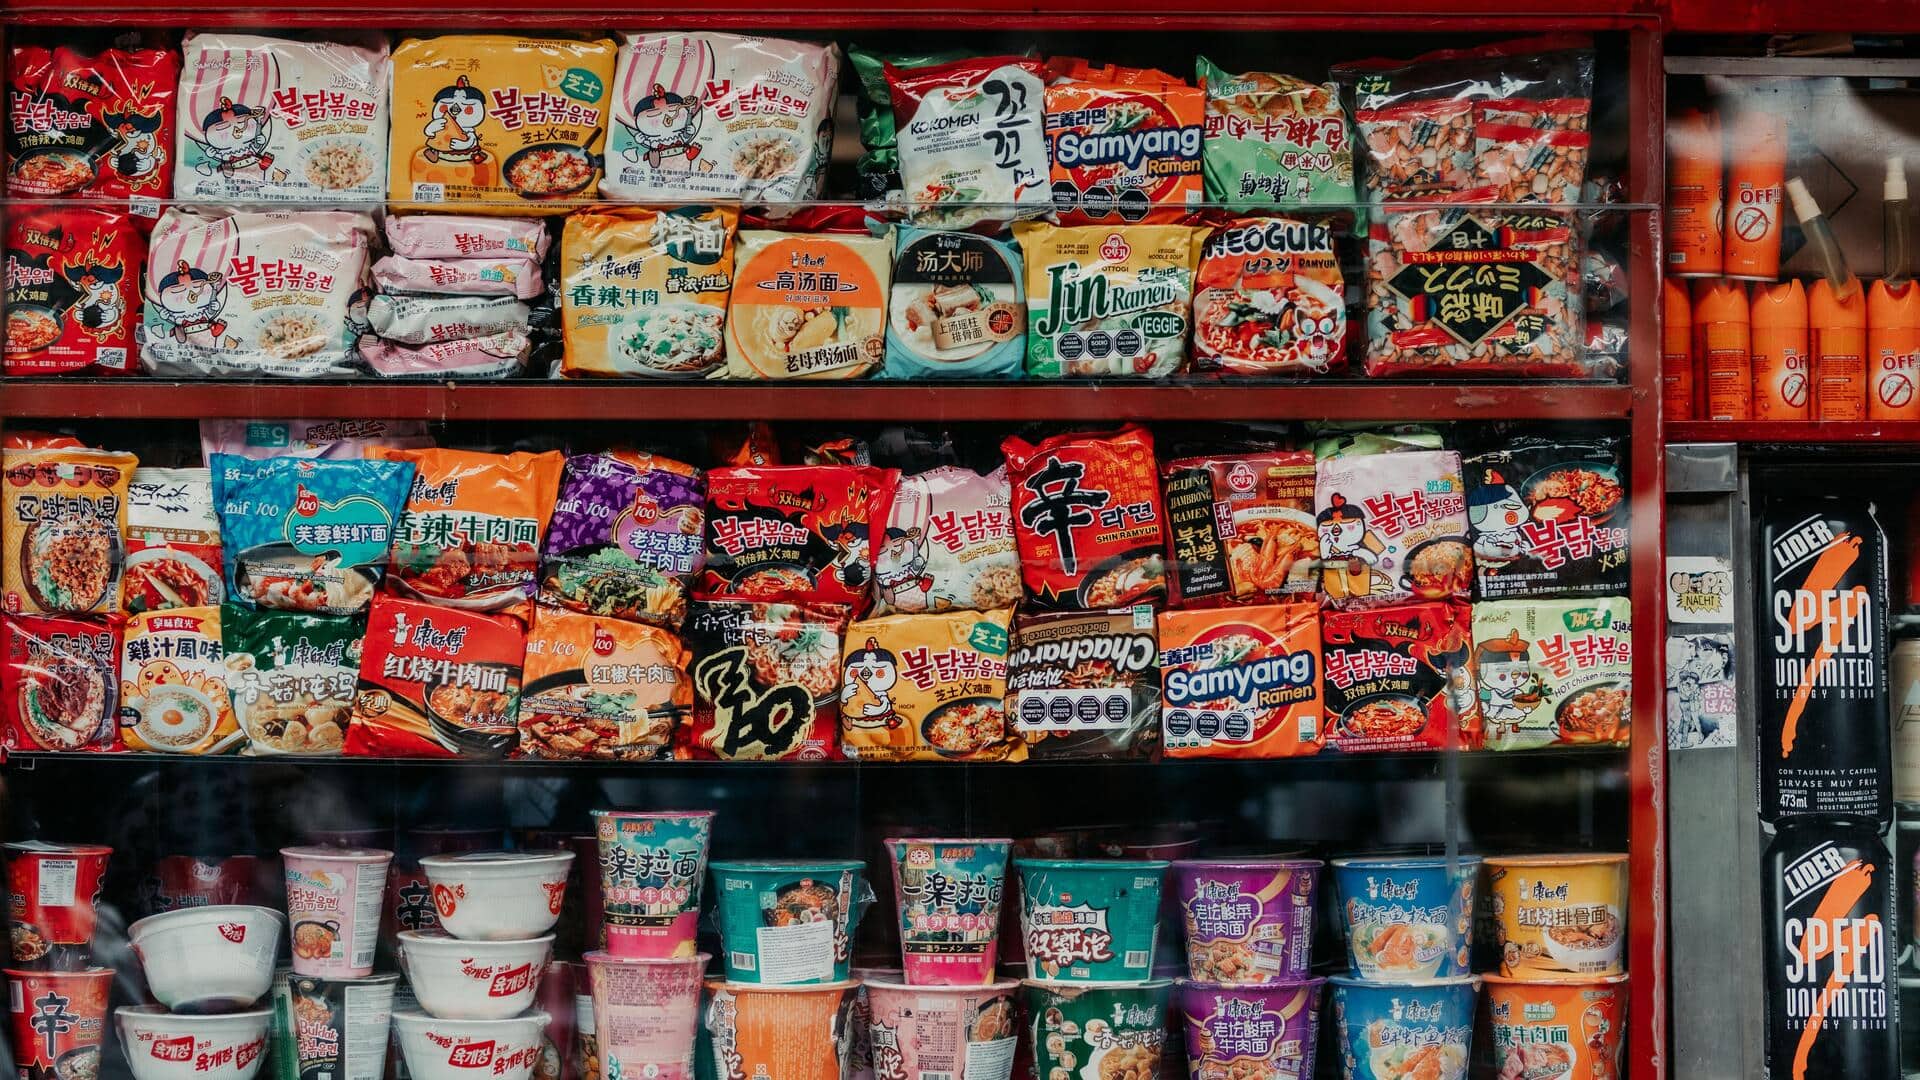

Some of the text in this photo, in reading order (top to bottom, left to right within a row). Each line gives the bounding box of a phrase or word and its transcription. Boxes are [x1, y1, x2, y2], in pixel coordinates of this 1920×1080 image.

[566, 72, 600, 97] 芝士
[270, 87, 379, 131] 불닭볶음면
[488, 86, 602, 131] 불닭볶음면
[703, 78, 812, 122] 불닭볶음면
[9, 92, 92, 132] 불닭볶음면
[911, 112, 980, 136] KOKOMEN
[1204, 115, 1349, 152] 泡椒牛肉面
[521, 127, 580, 145] 芝士火鸡面
[1058, 128, 1200, 165] Samyang
[1149, 160, 1201, 175] Ramen
[1120, 175, 1144, 187] 1963
[1239, 172, 1290, 203] 康師傅
[26, 229, 59, 251] 双倍辣
[649, 211, 724, 256] 拌面
[1452, 231, 1488, 248] 十色
[916, 249, 984, 273] 汤大师
[1246, 257, 1290, 273] 너구리
[226, 254, 336, 297] 불닭볶음면
[480, 268, 504, 282] 奶油
[775, 272, 839, 292] 高汤面
[1419, 264, 1521, 294] ミックス
[567, 285, 659, 309] 香辣牛肉
[1038, 262, 1110, 336] Jin
[1112, 284, 1173, 313] Ramen
[1440, 293, 1504, 323] 味彩
[1138, 316, 1180, 334] VEGGIE
[952, 328, 984, 345] 排骨面
[785, 347, 860, 374] 老母鸡汤面
[410, 475, 459, 507] 康師傅
[1268, 480, 1281, 489] Spicy
[1282, 479, 1303, 487] Seafood
[1426, 480, 1452, 493] 奶油
[255, 502, 280, 518] 100
[297, 500, 317, 511] 100
[586, 502, 610, 519] 100
[778, 491, 813, 511] 双倍辣
[634, 506, 656, 519] 100
[1020, 455, 1112, 577] 辛
[1101, 502, 1154, 529] 라면
[1173, 507, 1209, 524] RAMEN
[1217, 504, 1234, 536] 北京
[1364, 488, 1466, 537] 불닭볶음면
[295, 524, 388, 547] 芙蓉鲜虾面
[391, 511, 538, 549] 香辣牛肉面
[712, 515, 809, 557] 불닭볶음면
[1096, 526, 1159, 545] SHIN RAMYUN
[1176, 524, 1213, 546] 북경
[630, 530, 705, 555] 老坛酸菜
[1178, 542, 1219, 564] 짬뽕
[1774, 519, 1835, 569] LIDER
[640, 550, 694, 573] 牛肉面
[734, 549, 801, 567] 双倍辣火鸡面
[1190, 573, 1217, 583] Seafood
[1193, 566, 1211, 575] Spicy
[1203, 581, 1223, 591] Flavor
[1029, 622, 1110, 642] Blackbean Sauce
[1384, 623, 1419, 640] 双倍辣
[1774, 589, 1873, 654] SPEED
[412, 618, 466, 656] 康師傅
[593, 638, 612, 650] 100
[974, 625, 1007, 650] 芝士
[127, 637, 222, 664] 雞汁風味
[290, 638, 345, 667] 康師傅
[552, 641, 576, 657] 100
[383, 652, 509, 694] 红烧牛肉面
[591, 665, 676, 686] 红椒牛肉面
[901, 646, 1007, 691] 불닭볶음면
[1168, 654, 1310, 702] Samyang
[1325, 650, 1417, 690] 불닭볶음면
[1775, 657, 1874, 688] UNLIMITED
[239, 671, 357, 707] 香菇炖鸡
[935, 682, 993, 702] 芝士火鸡面
[1259, 686, 1313, 707] Ramen
[1343, 678, 1411, 701] 双倍辣火鸡面
[1554, 682, 1571, 698] HOT
[1572, 673, 1599, 689] Chicken
[1776, 687, 1875, 700] ENERGY DRINK
[1798, 768, 1836, 776] TAURINA
[1849, 767, 1877, 775] CAFEINA
[1779, 778, 1878, 788] SIRVASE MUY FRIA
[1780, 794, 1808, 809] 473ml
[1784, 846, 1848, 898] LIDER
[1380, 878, 1419, 900] 康師傅
[1532, 881, 1570, 902] 康師傅
[1195, 903, 1252, 922] 老坛酸菜
[1351, 905, 1449, 926] 鲜虾鱼板面
[1518, 905, 1608, 927] 红烧排骨面
[1200, 921, 1246, 937] 牛肉面
[1785, 918, 1885, 984] SPEED
[493, 973, 528, 994] 육개장
[1787, 987, 1887, 1018] UNLIMITED
[32, 991, 80, 1060] 辛
[300, 1019, 339, 1043] Buldak
[1214, 1020, 1276, 1039] 老坛酸菜
[1787, 1019, 1887, 1030] ENERGY DRINK
[155, 1041, 190, 1060] 육개장
[452, 1047, 491, 1066] 육개장
[1220, 1038, 1269, 1054] 牛肉面
[195, 1046, 234, 1072] 육개장
[494, 1049, 524, 1075] 육개장
